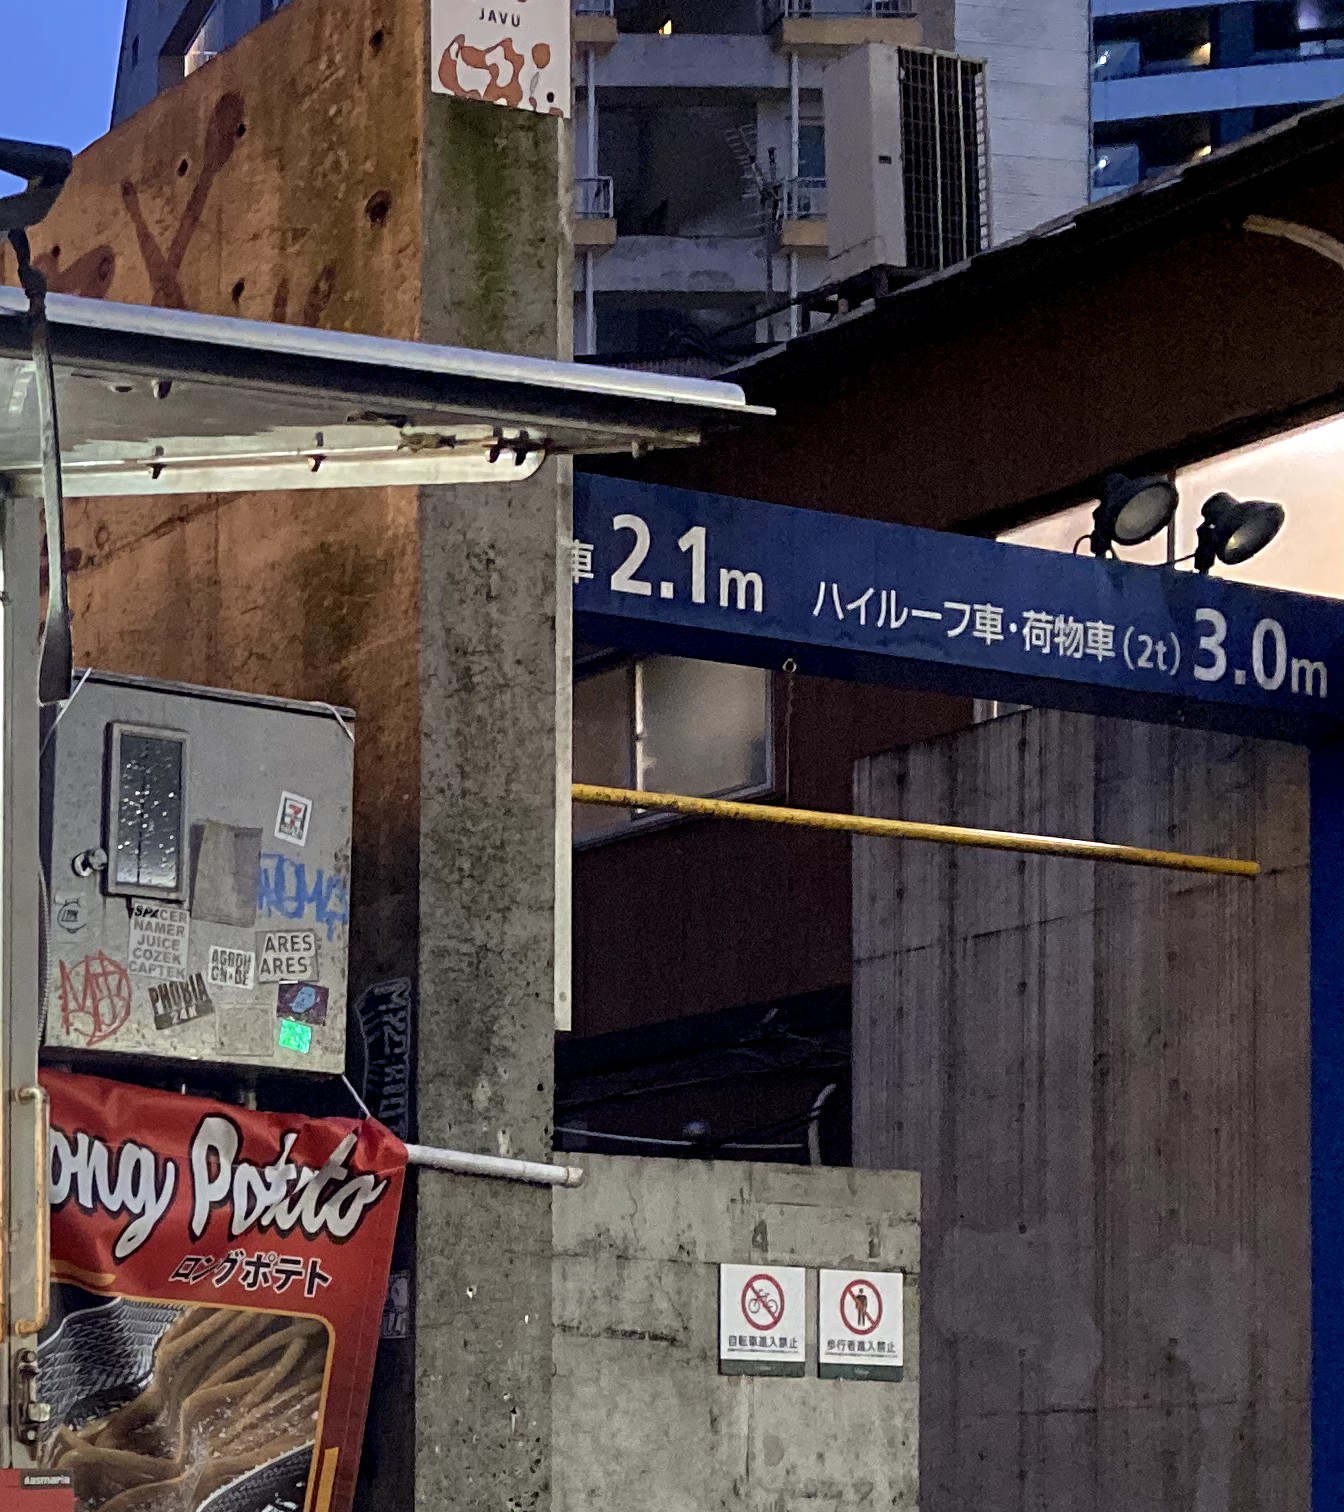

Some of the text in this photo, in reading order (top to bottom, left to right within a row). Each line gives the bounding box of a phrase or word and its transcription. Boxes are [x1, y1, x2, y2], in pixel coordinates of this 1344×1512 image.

[478, 7, 521, 28] JAVU
[611, 513, 763, 613] 2.1m
[813, 581, 1116, 663] ハイルーフ車・荷物車
[1123, 625, 1181, 676] (2t)
[1193, 607, 1328, 699] 3.0m
[133, 919, 186, 937] NAMER
[137, 934, 181, 950] JUICE
[265, 934, 313, 954] ARES
[261, 956, 308, 976] ARES
[170, 1251, 332, 1298] ロングポテト
[728, 1334, 799, 1350] 自転車進入禁止
[826, 1338, 897, 1354] 歩行者進入禁止
